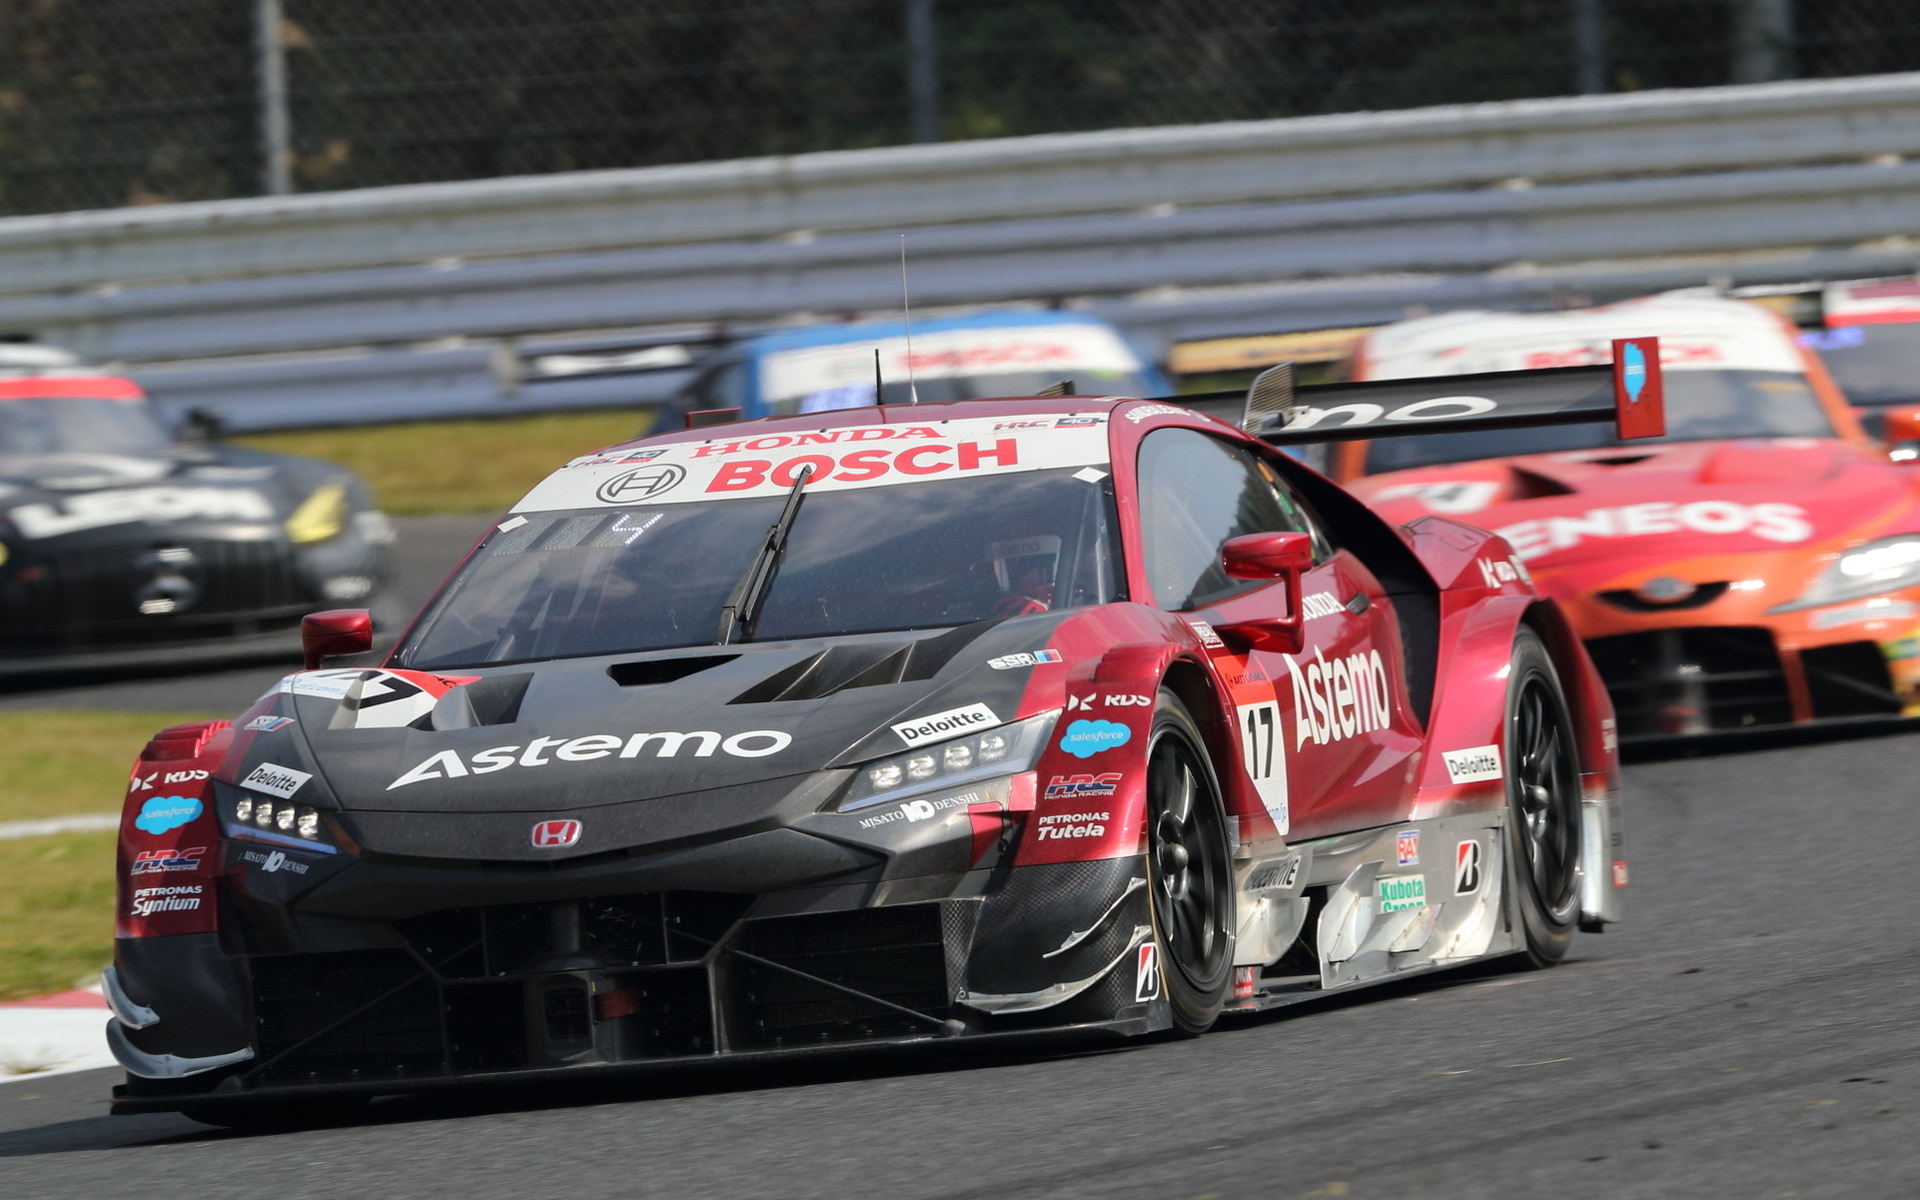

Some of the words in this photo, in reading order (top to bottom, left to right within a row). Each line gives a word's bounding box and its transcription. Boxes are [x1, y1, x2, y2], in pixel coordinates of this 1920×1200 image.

[689, 427, 946, 459] HONDA
[705, 438, 1018, 493] BOSCH
[1496, 502, 1813, 562] ENEOS
[1282, 645, 1391, 753] Astemo
[1070, 731, 1124, 742] salesforce
[1247, 706, 1273, 780] 17
[385, 730, 792, 791] Astemo
[1045, 772, 1123, 795] HRC
[145, 807, 197, 819] salesforce
[858, 810, 905, 829] MISATO
[933, 792, 980, 810] DENSHI
[1039, 812, 1110, 825] PETRONAS
[1038, 822, 1105, 841] Tutela
[131, 846, 207, 871] HRC
[134, 885, 203, 898] PETRONAS
[1381, 880, 1424, 901] Kubota
[131, 895, 201, 917] Syntium
